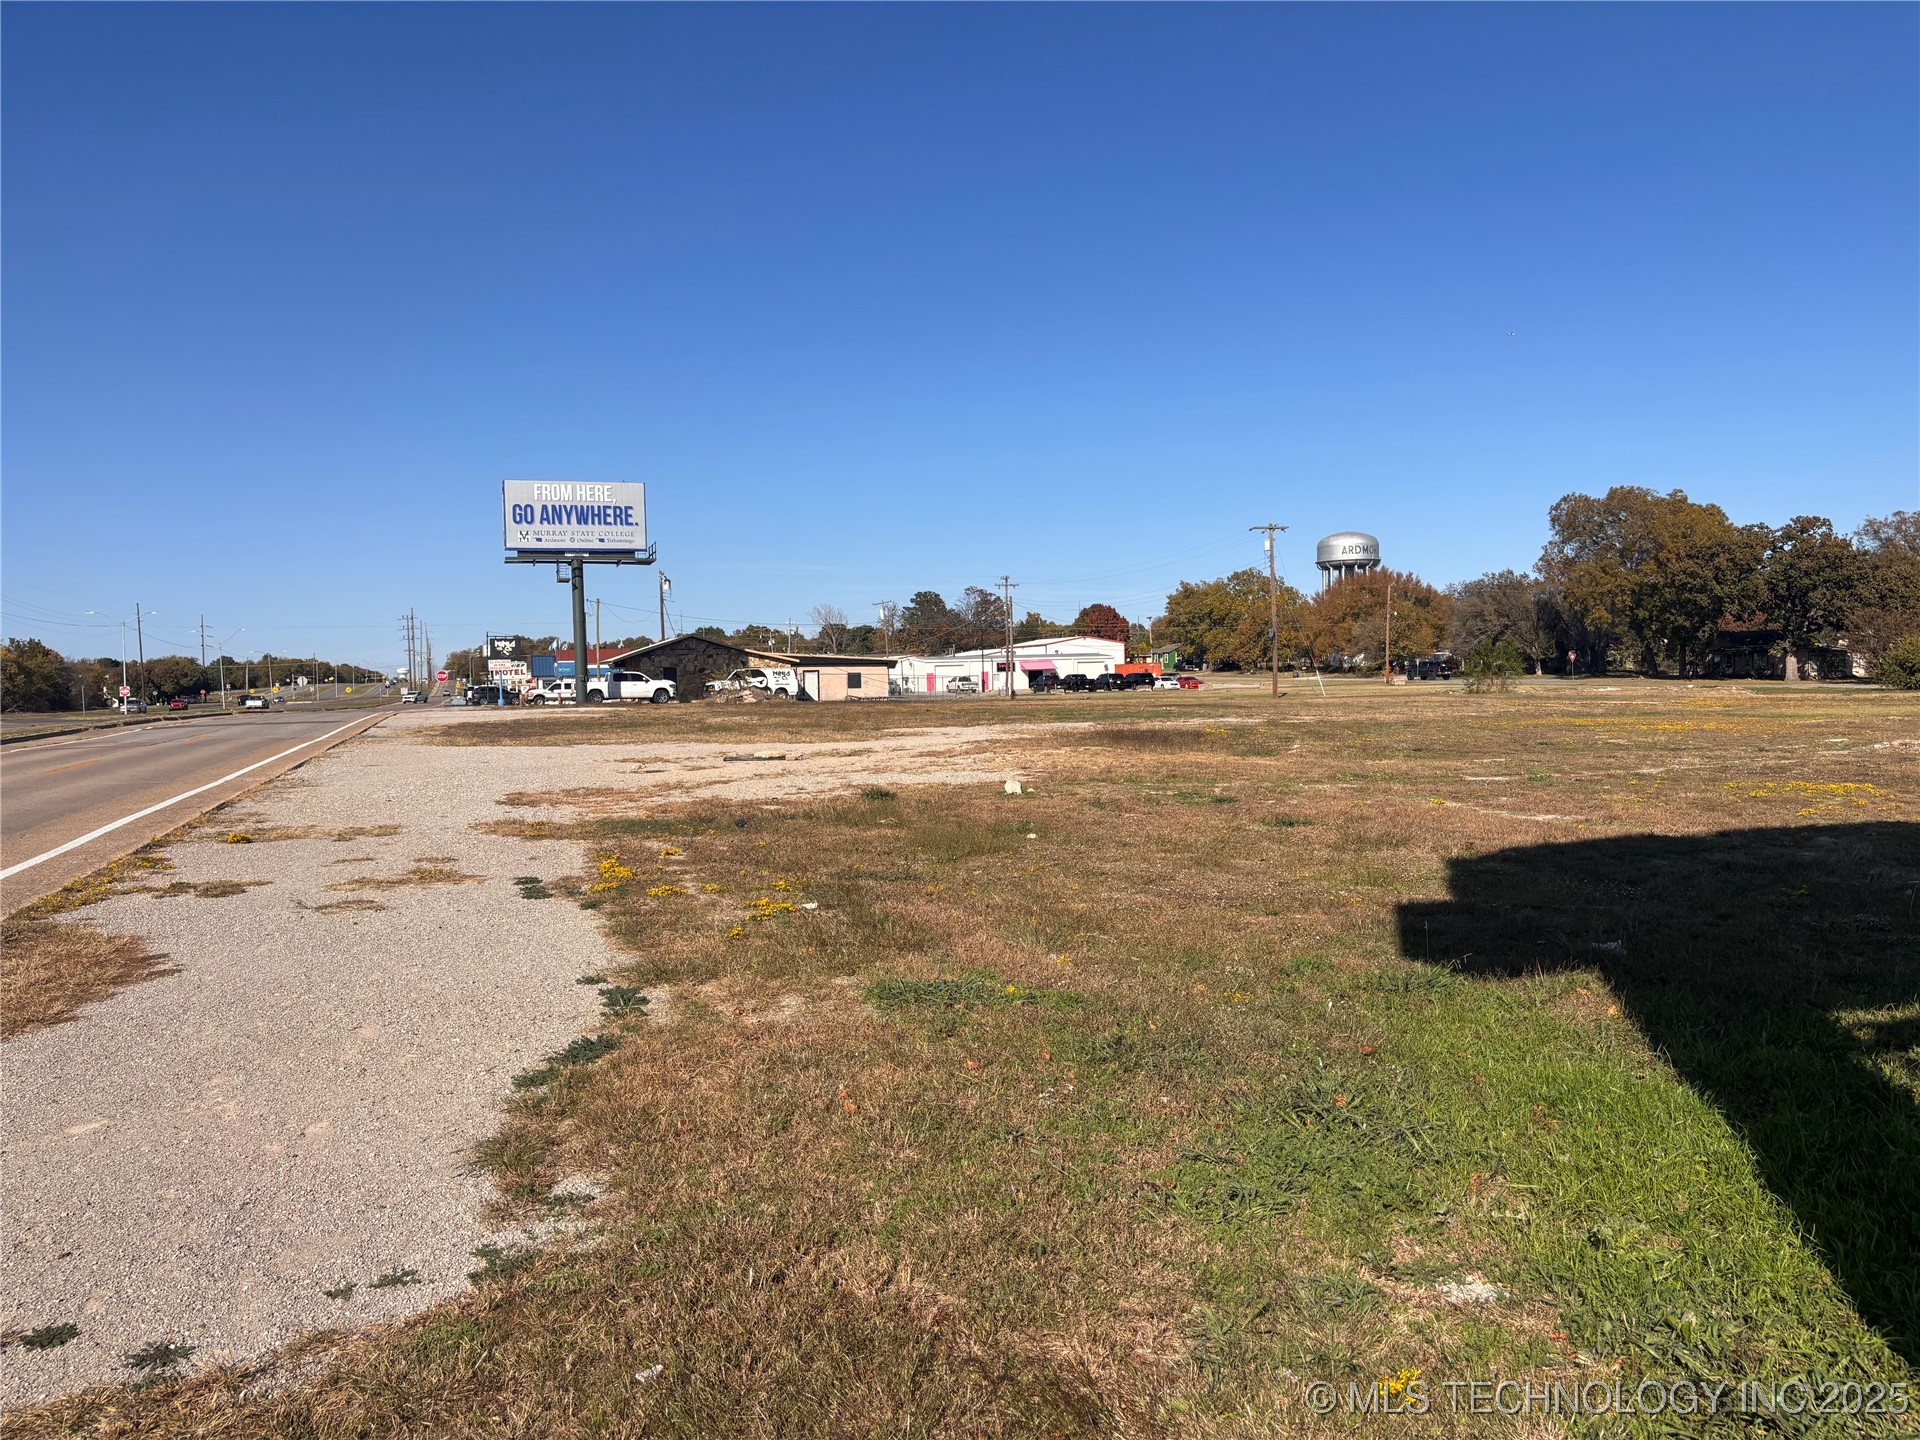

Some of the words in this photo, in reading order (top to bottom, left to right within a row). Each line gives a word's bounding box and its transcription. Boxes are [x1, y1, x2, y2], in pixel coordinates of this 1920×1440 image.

[533, 483, 573, 502] FROM
[576, 485, 617, 504] HERE,
[512, 503, 535, 525] GO
[539, 504, 640, 526] ANYWHERE.
